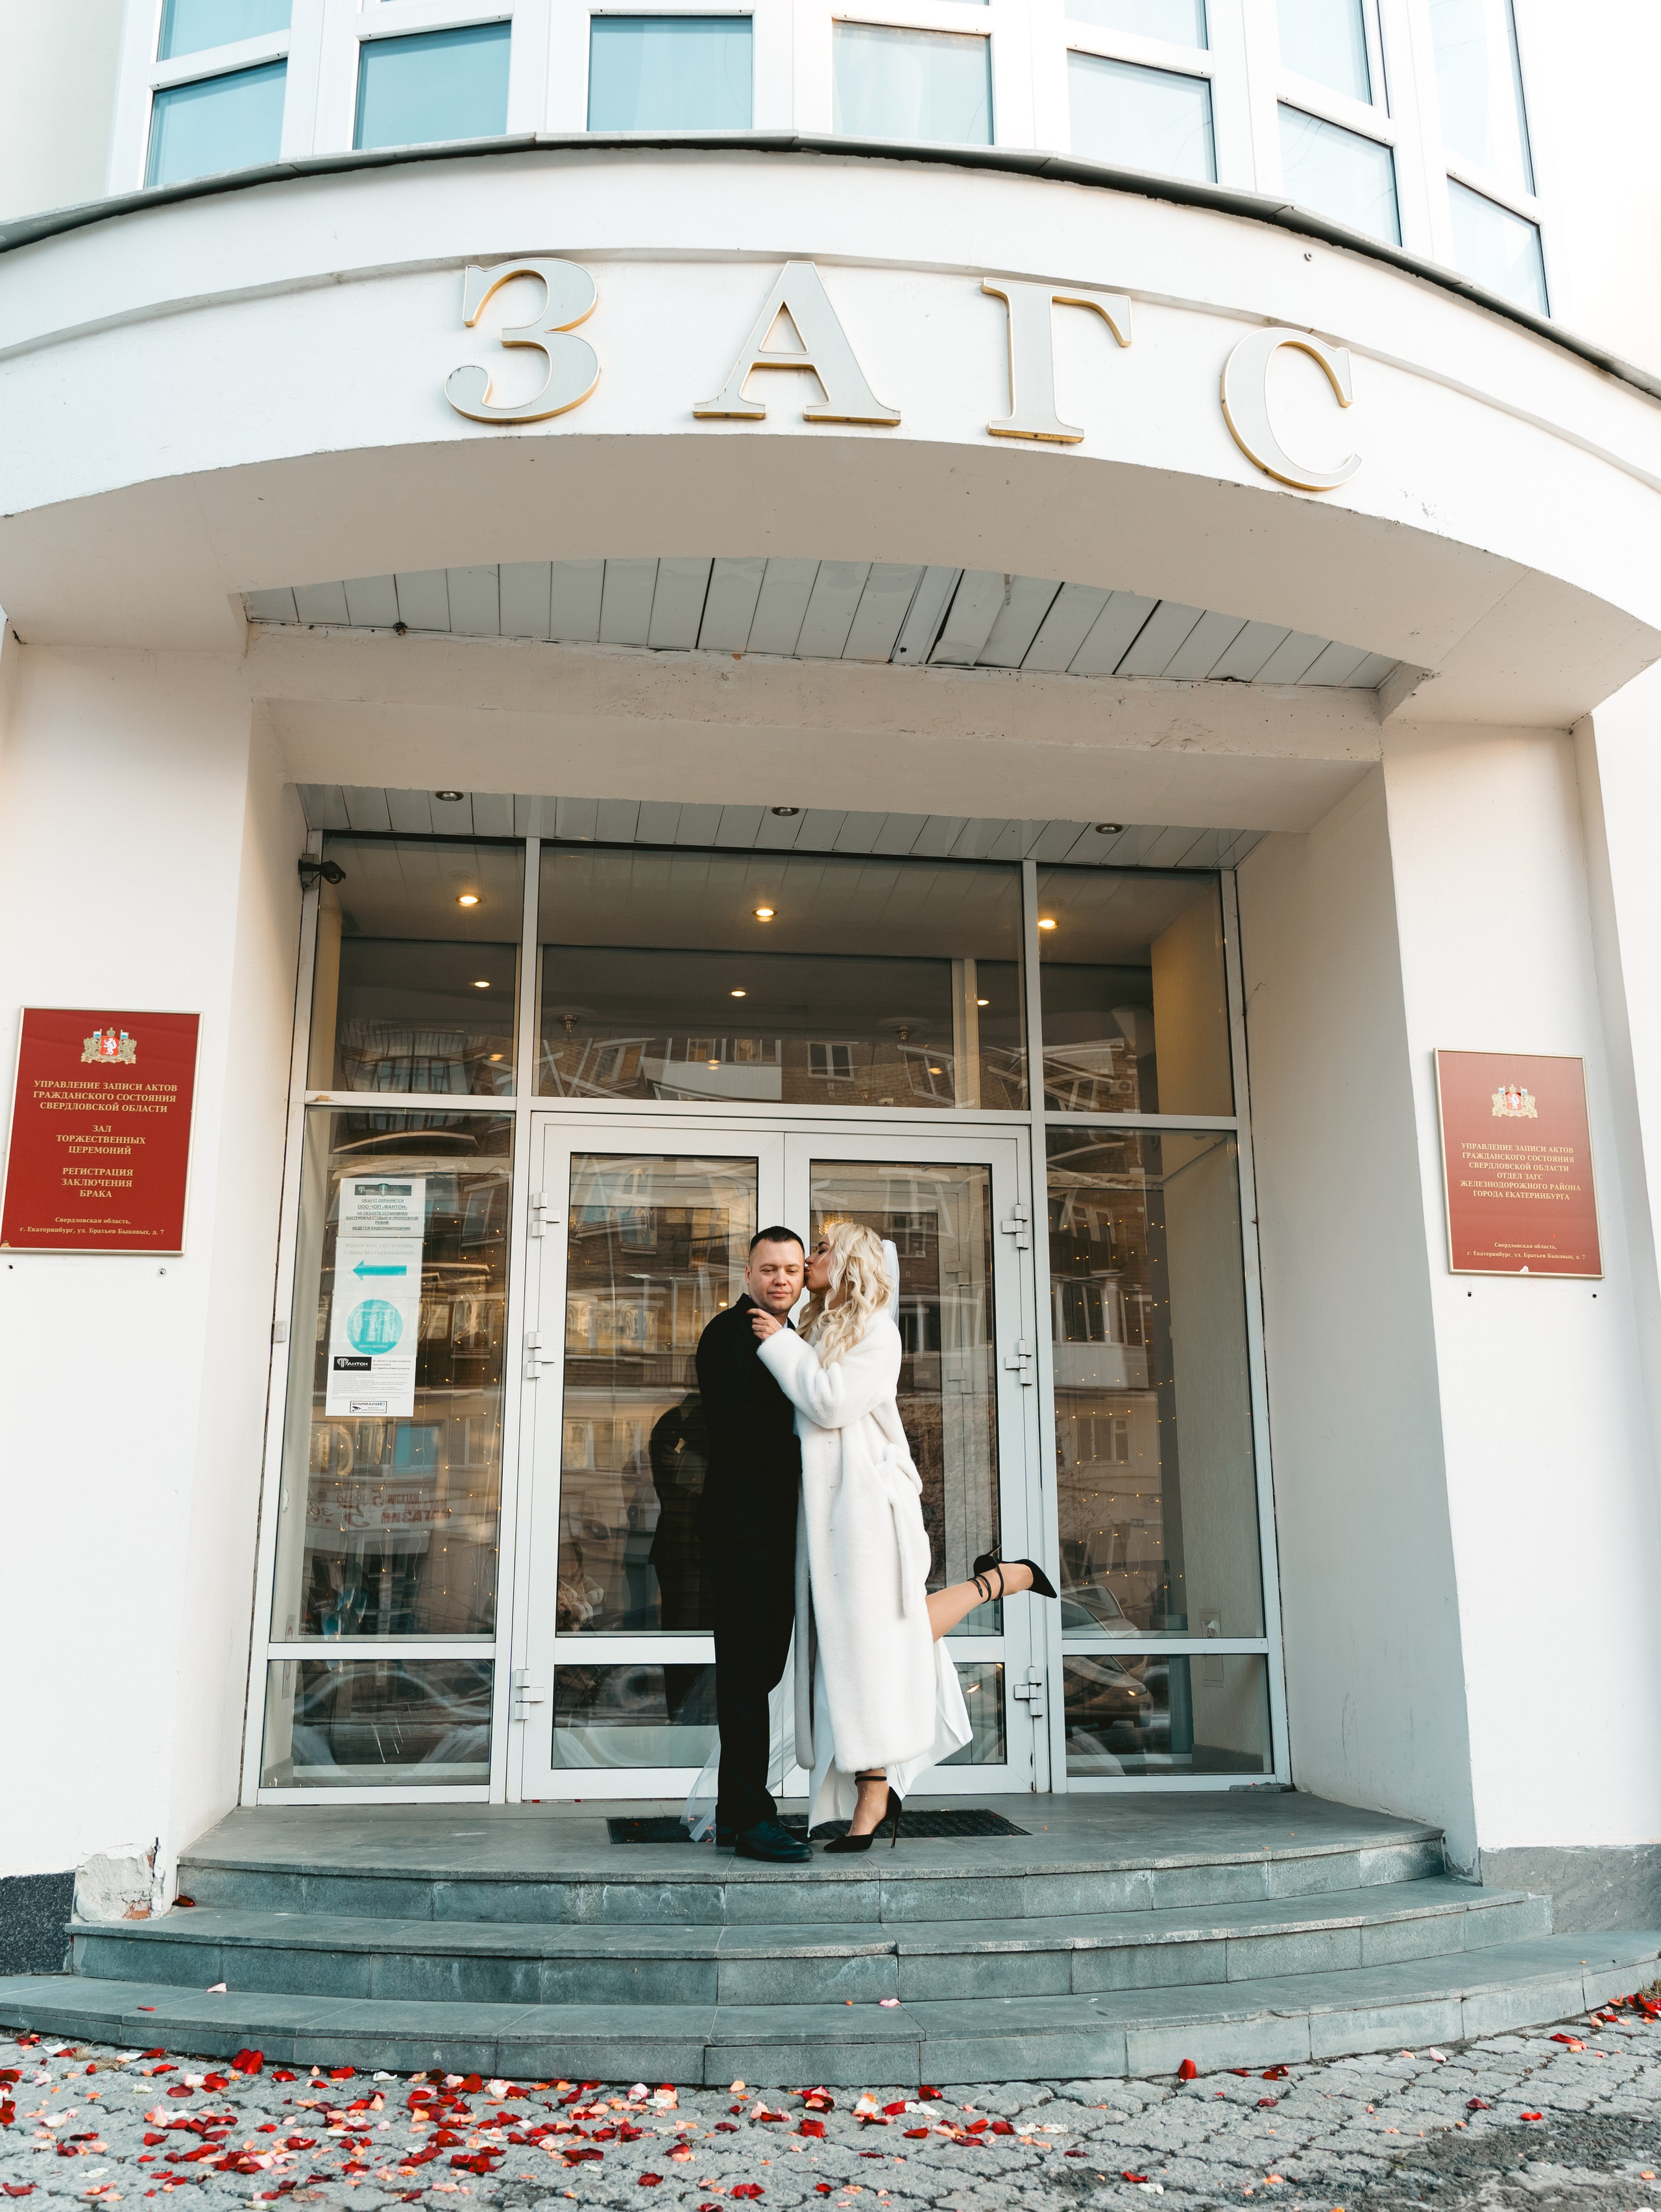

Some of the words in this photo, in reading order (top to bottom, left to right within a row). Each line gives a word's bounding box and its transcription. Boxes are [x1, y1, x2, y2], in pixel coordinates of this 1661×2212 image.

[444, 257, 1363, 491] ЗАГС
[34, 1080, 101, 1090] УПРАВЛЕНИЕ
[103, 1081, 142, 1090] ЗАПИСИ
[145, 1083, 178, 1092] АКТОВ
[33, 1090, 114, 1101] ГРАЖДАНСКОГО
[116, 1093, 176, 1102] СОСТОЯНИЯ
[40, 1101, 119, 1112] СВЕРДЛОВСКОЙ
[122, 1103, 168, 1112] ОБЛАСТИ
[56, 1135, 146, 1144] ТОРЖЕСТВЕННЫХ
[68, 1146, 132, 1155] ЦЕРЕМОНИЙ
[1461, 1142, 1513, 1151] УПРАВЛЕНИЕ
[1514, 1144, 1546, 1153] ЗАПИСИ
[1462, 1152, 1525, 1161] ГРАЖДАНСКОГО
[1469, 1162, 1531, 1170] СВЕРДЛОВСКОЙ
[62, 1167, 134, 1177] РЕГИСТРАЦИЯ
[61, 1178, 132, 1188] ЗАКЛЮЧЕНИЯ
[1460, 1180, 1548, 1190] ЖЕЛЕЗНОДОРОЖНОГО
[1549, 1182, 1581, 1191] РАЙОНА
[79, 1190, 112, 1198] БРАКА
[1473, 1190, 1504, 1198] ГОРОДА
[1505, 1191, 1570, 1200] ЕКАТЕРИНБУРГА
[55, 1216, 102, 1225] Свердловская
[27, 1226, 76, 1234] Екатеринбург,
